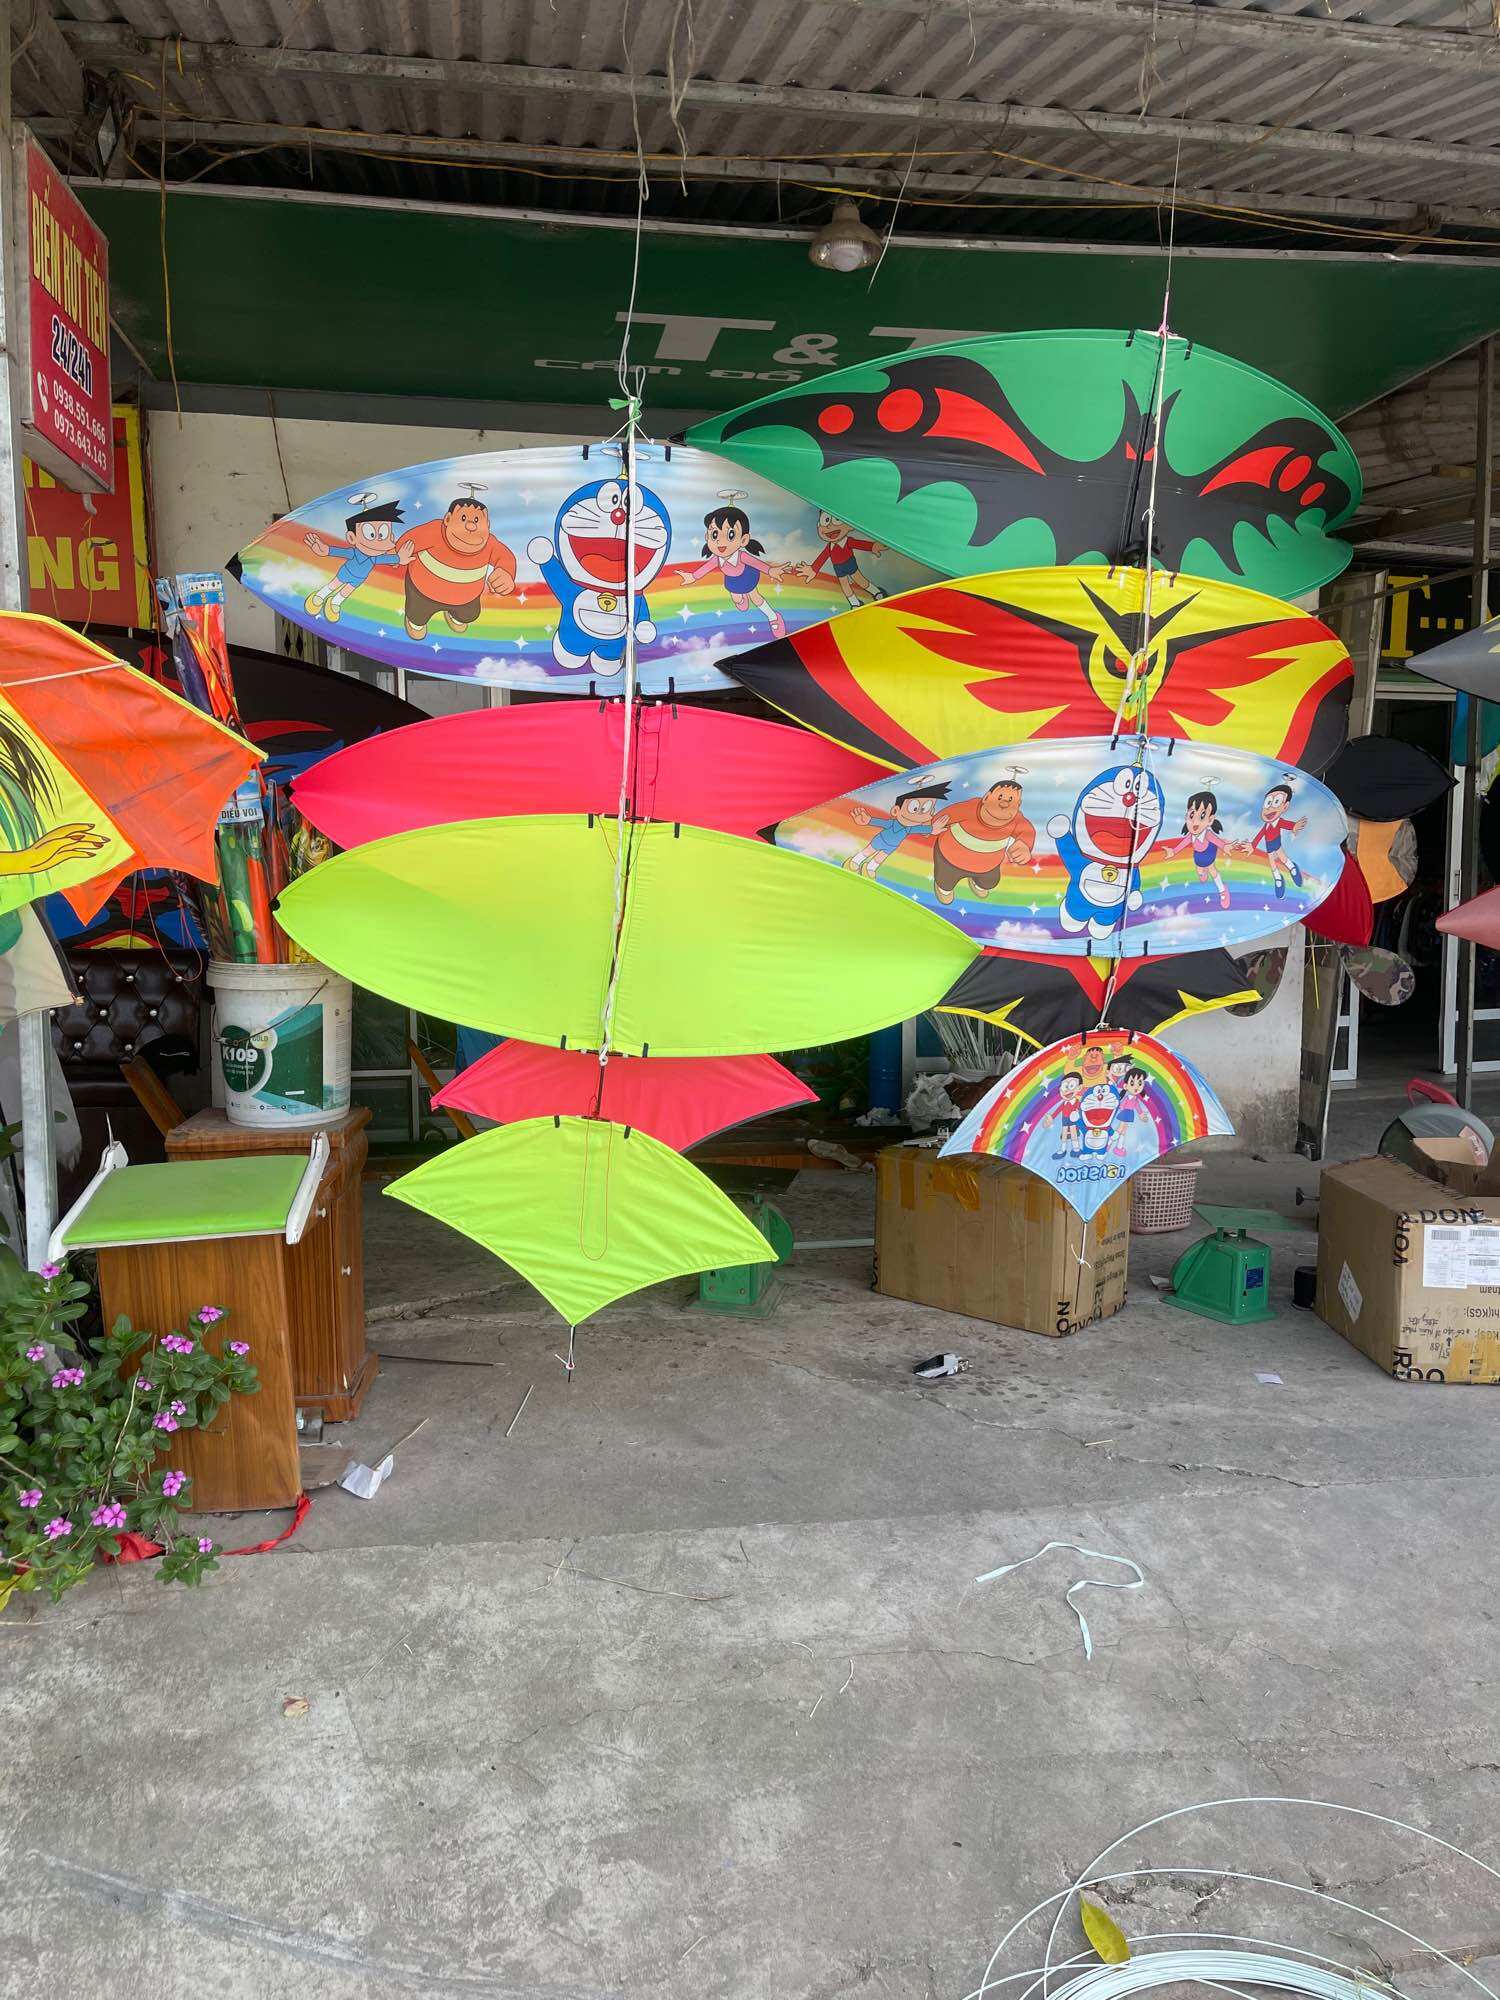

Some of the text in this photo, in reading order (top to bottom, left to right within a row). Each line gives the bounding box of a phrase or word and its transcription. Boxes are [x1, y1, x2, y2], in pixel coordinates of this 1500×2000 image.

[63, 224, 82, 328] RÚT
[52, 315, 92, 399] 24/24h
[53, 380, 106, 445] 0938.551.666
[54, 409, 107, 471] 0973.643.143
[222, 1046, 258, 1062] K109
